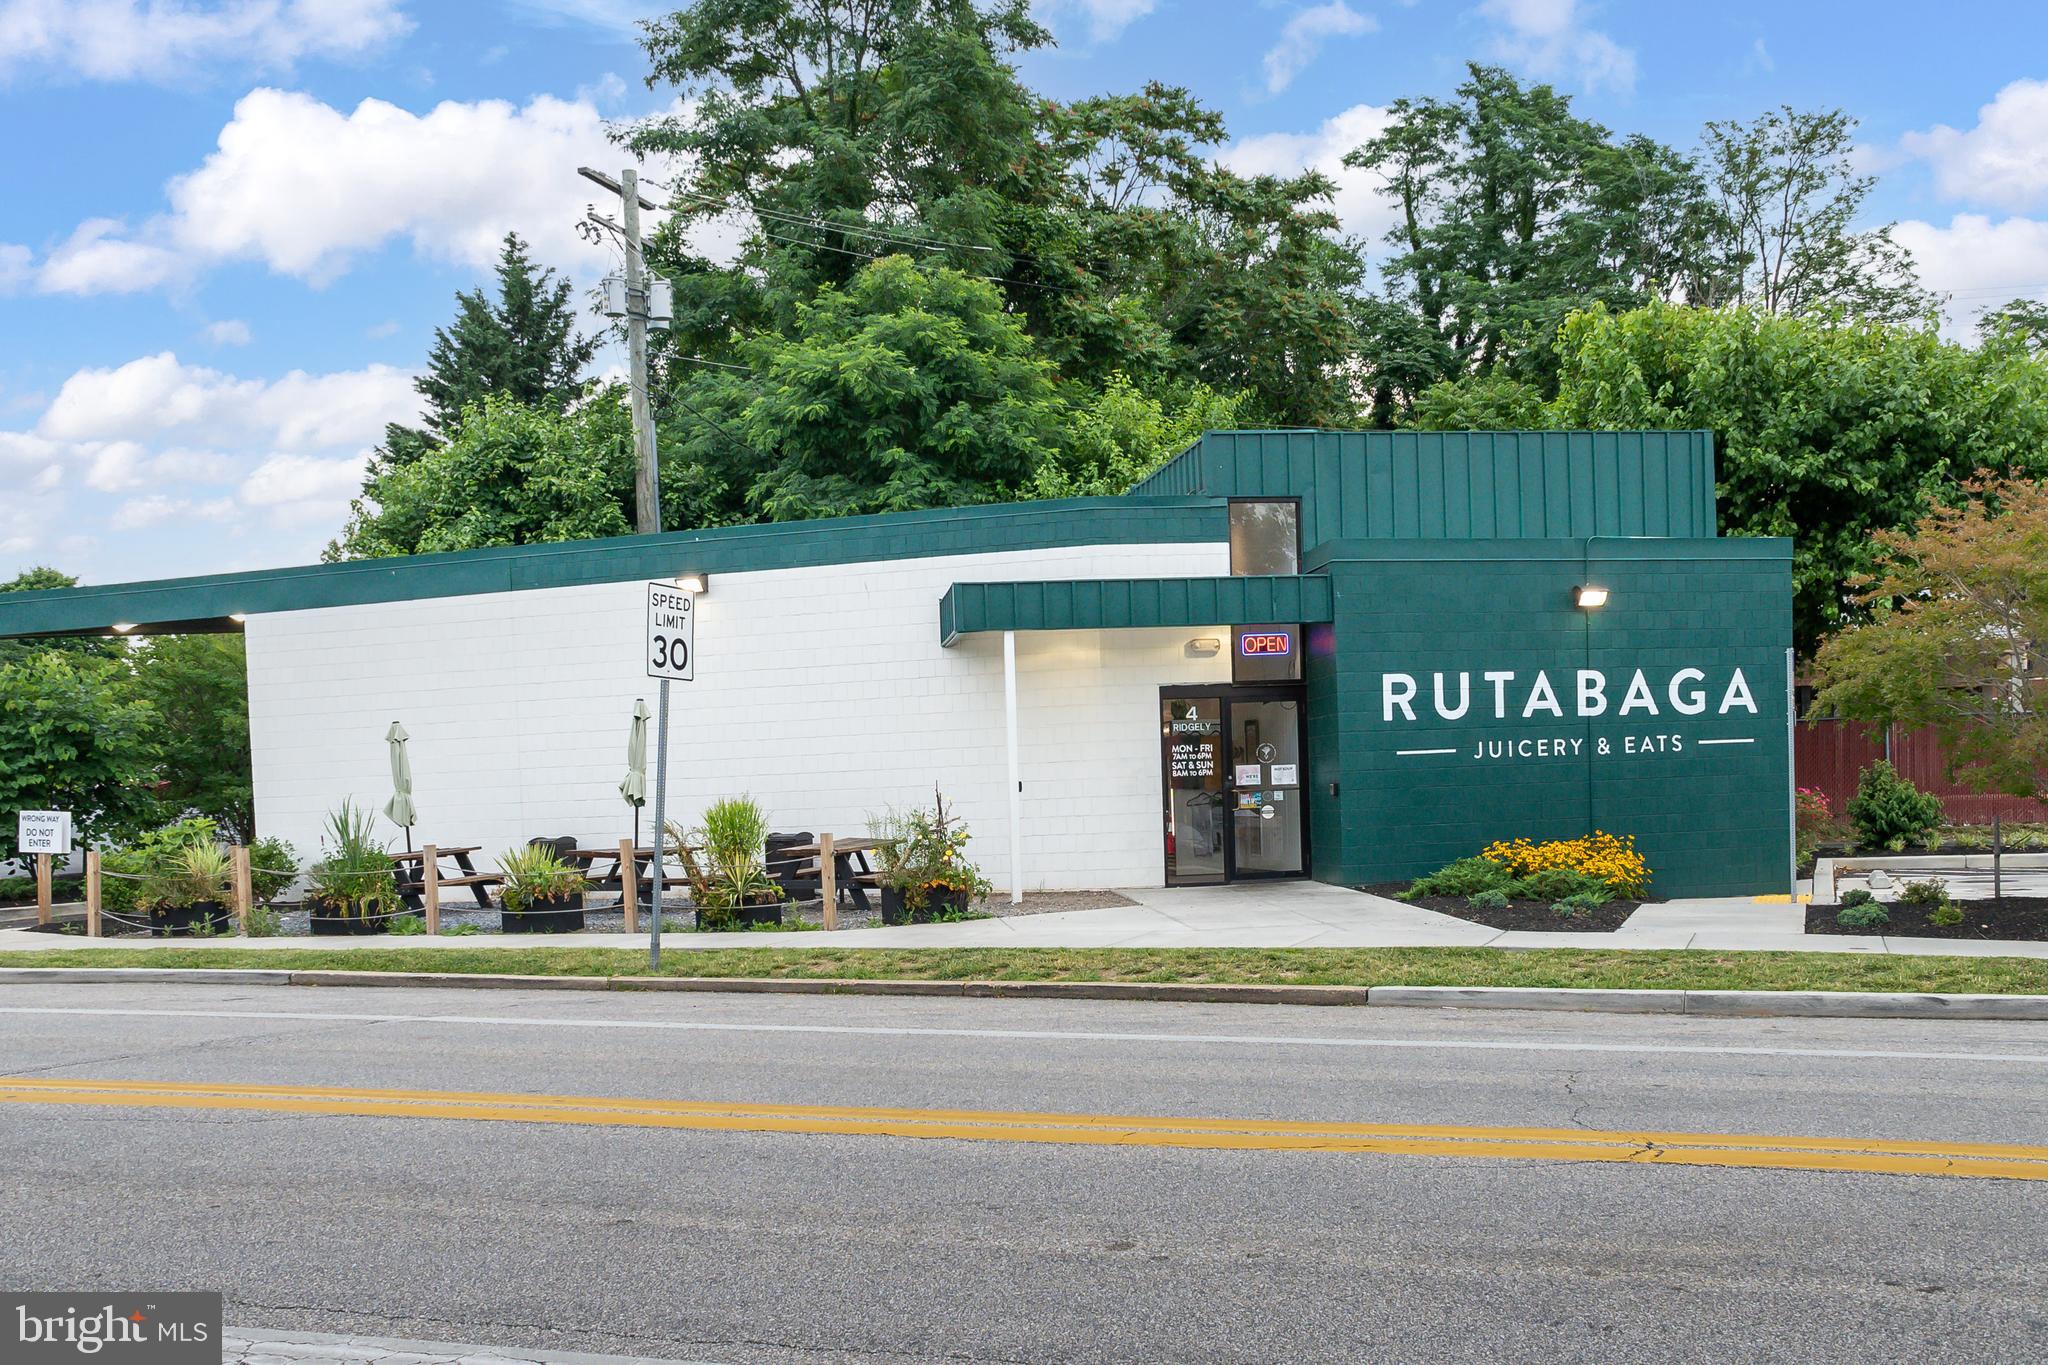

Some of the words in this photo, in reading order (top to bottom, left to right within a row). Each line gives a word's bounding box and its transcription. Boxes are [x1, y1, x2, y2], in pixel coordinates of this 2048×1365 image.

[652, 593, 691, 611] SPEED
[655, 612, 686, 630] LIMIT
[1244, 636, 1287, 653] OPEN
[652, 635, 688, 671] 30
[1382, 667, 1758, 721] RUTABAGA
[1185, 706, 1198, 721] 4
[1173, 722, 1211, 731] RIDGELY
[1171, 744, 1193, 753] MON
[1200, 744, 1213, 752] FRI
[1473, 738, 1584, 759] JUICERY
[1597, 737, 1611, 755] &
[1624, 734, 1683, 754] EATS
[1197, 752, 1212, 760] 6PM
[1171, 761, 1187, 770] SAT
[1188, 761, 1195, 769] &
[1196, 761, 1214, 769] SUN
[1198, 769, 1214, 777] 6PM
[26, 828, 38, 837] DO
[39, 828, 54, 837] NOT
[28, 839, 51, 847] ENTER
